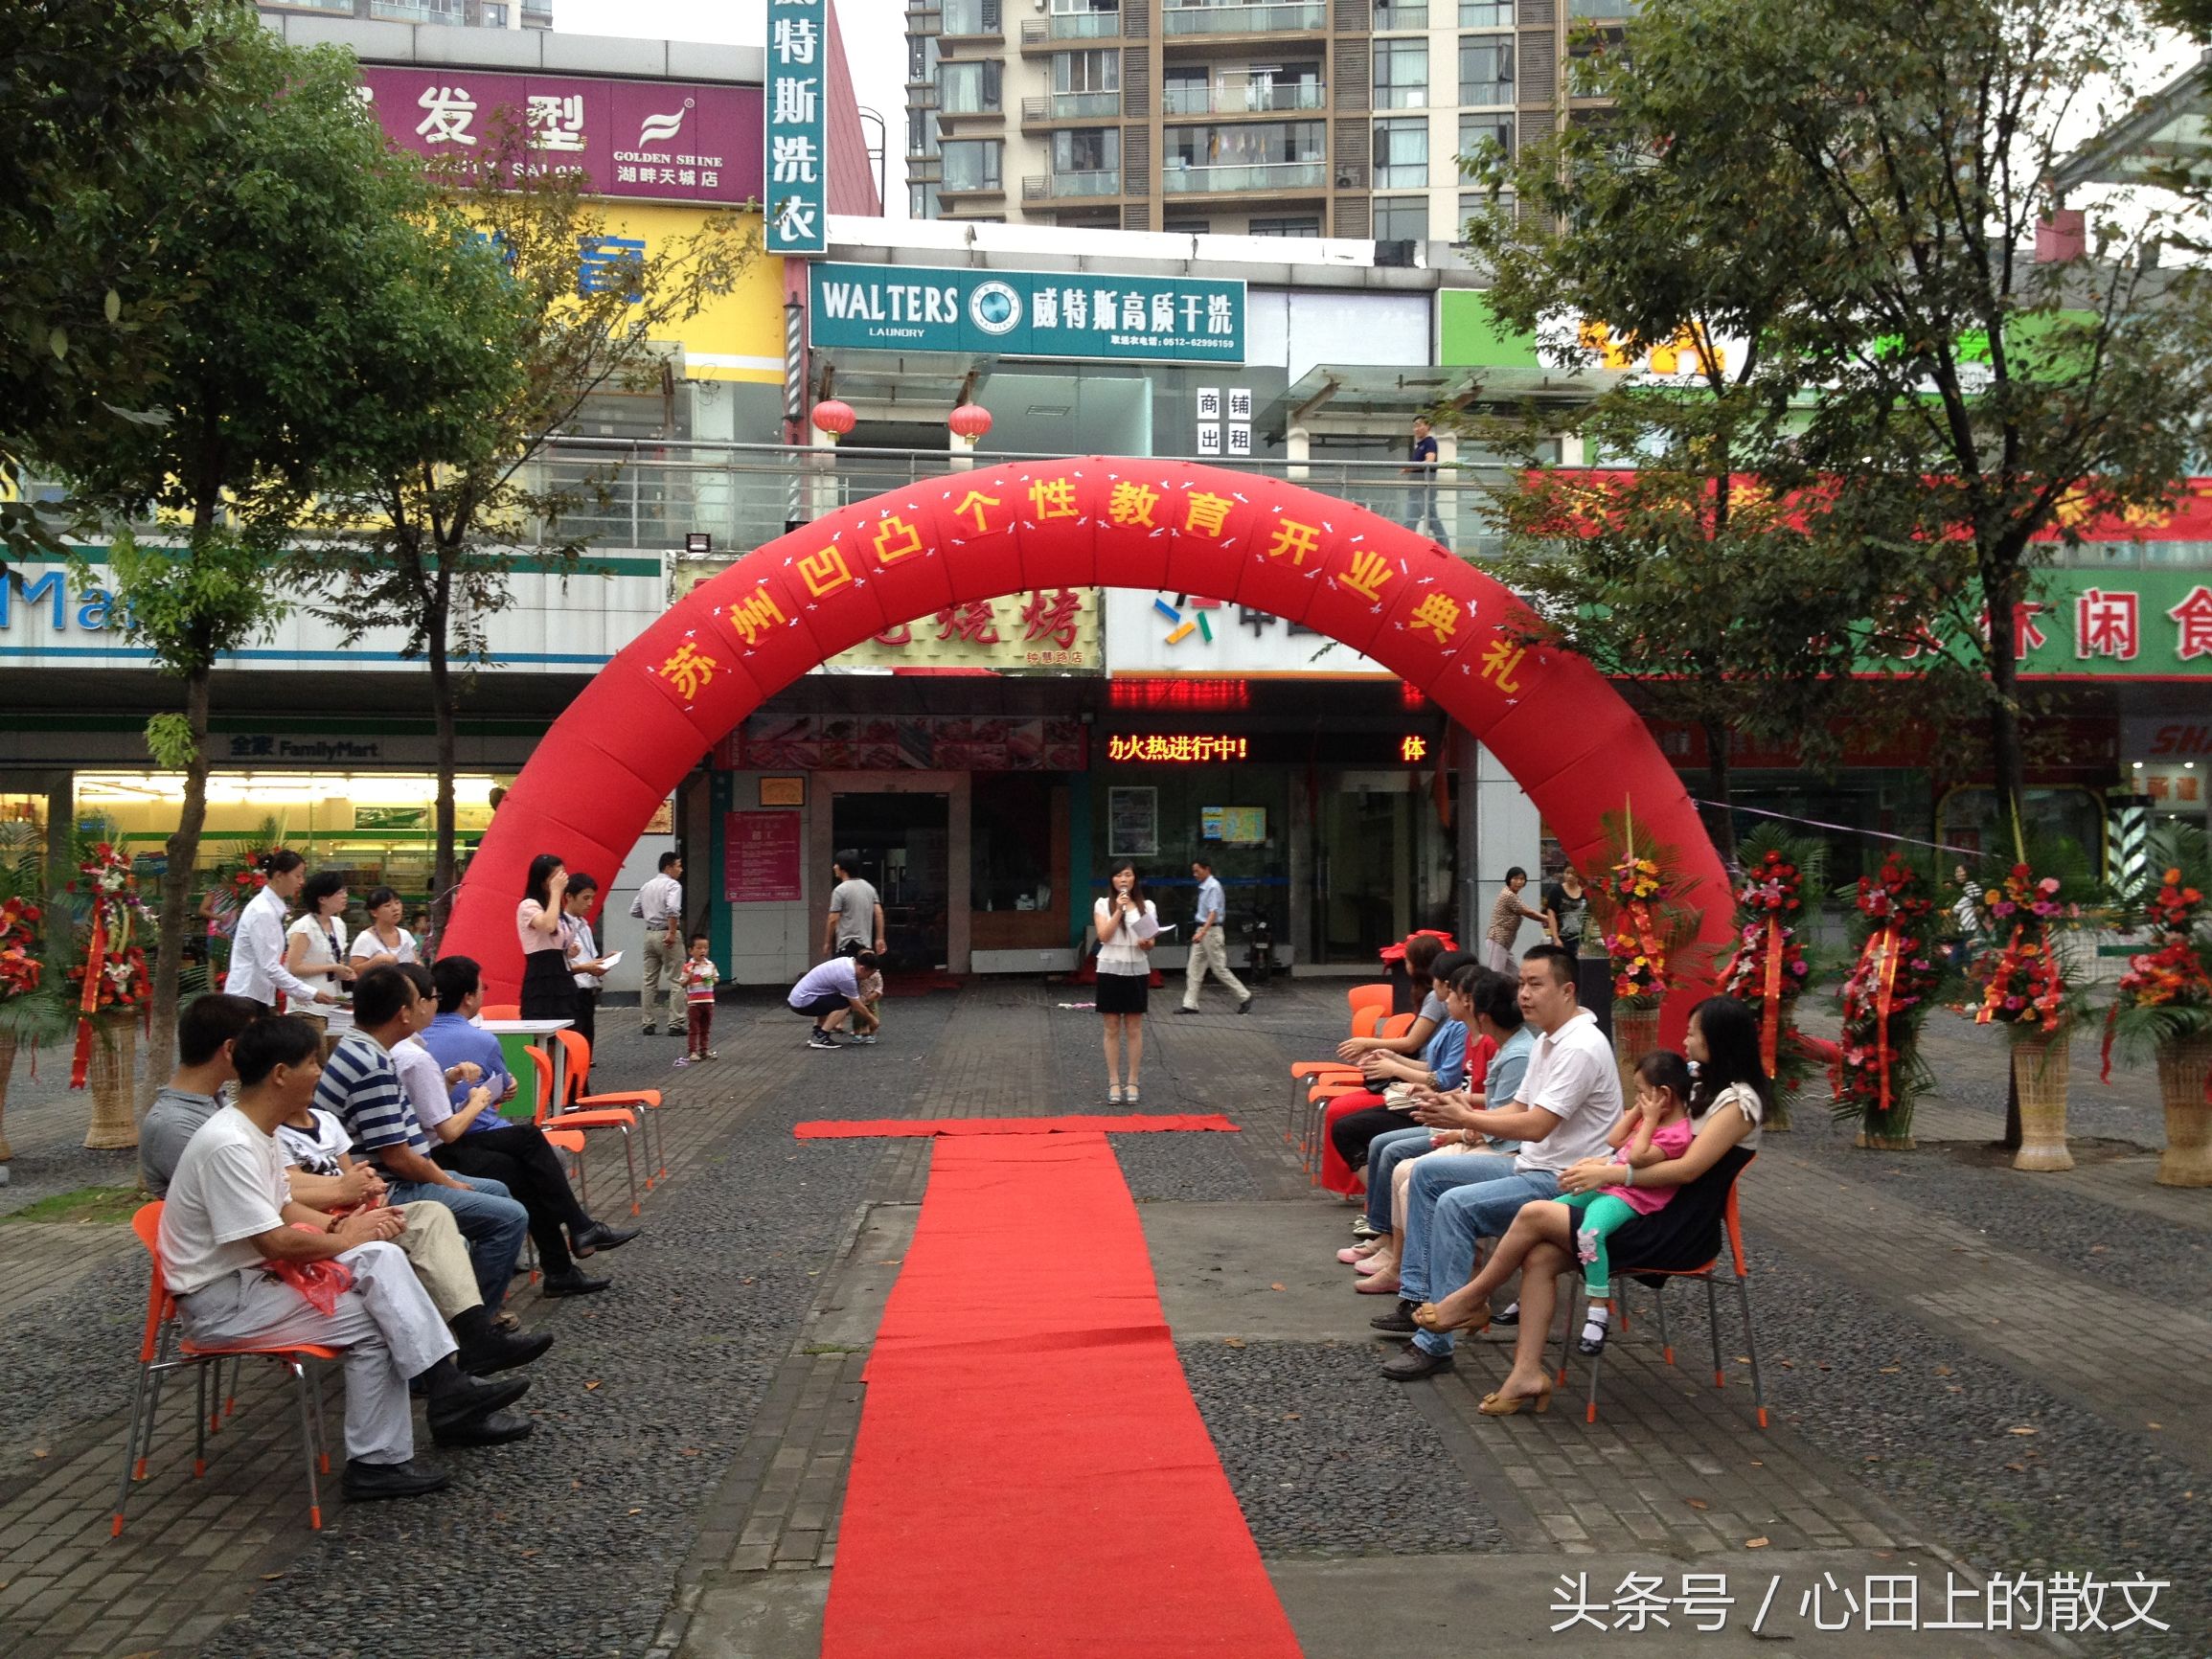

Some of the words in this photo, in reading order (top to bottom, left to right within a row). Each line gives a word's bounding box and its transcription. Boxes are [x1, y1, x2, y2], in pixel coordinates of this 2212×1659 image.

[356, 86, 584, 151] 发型
[772, 0, 818, 242] 特斯洗衣
[613, 150, 672, 164] GOLDEN
[675, 154, 723, 167] SHINE
[617, 165, 718, 188] 湖畔天城店
[822, 281, 958, 324] WALTERS
[1032, 287, 1233, 334] 威特斯高质干洗
[869, 327, 925, 338] LAUNDRY
[1199, 394, 1250, 414] 商铺
[1201, 429, 1250, 449] 出租
[658, 476, 1529, 701] 苏州凹凸个性教育开业典礼
[1026, 650, 1083, 665] 钟慧路店
[230, 735, 274, 757] 全家
[279, 740, 378, 761] FamilyMart
[1402, 736, 1425, 761] 体
